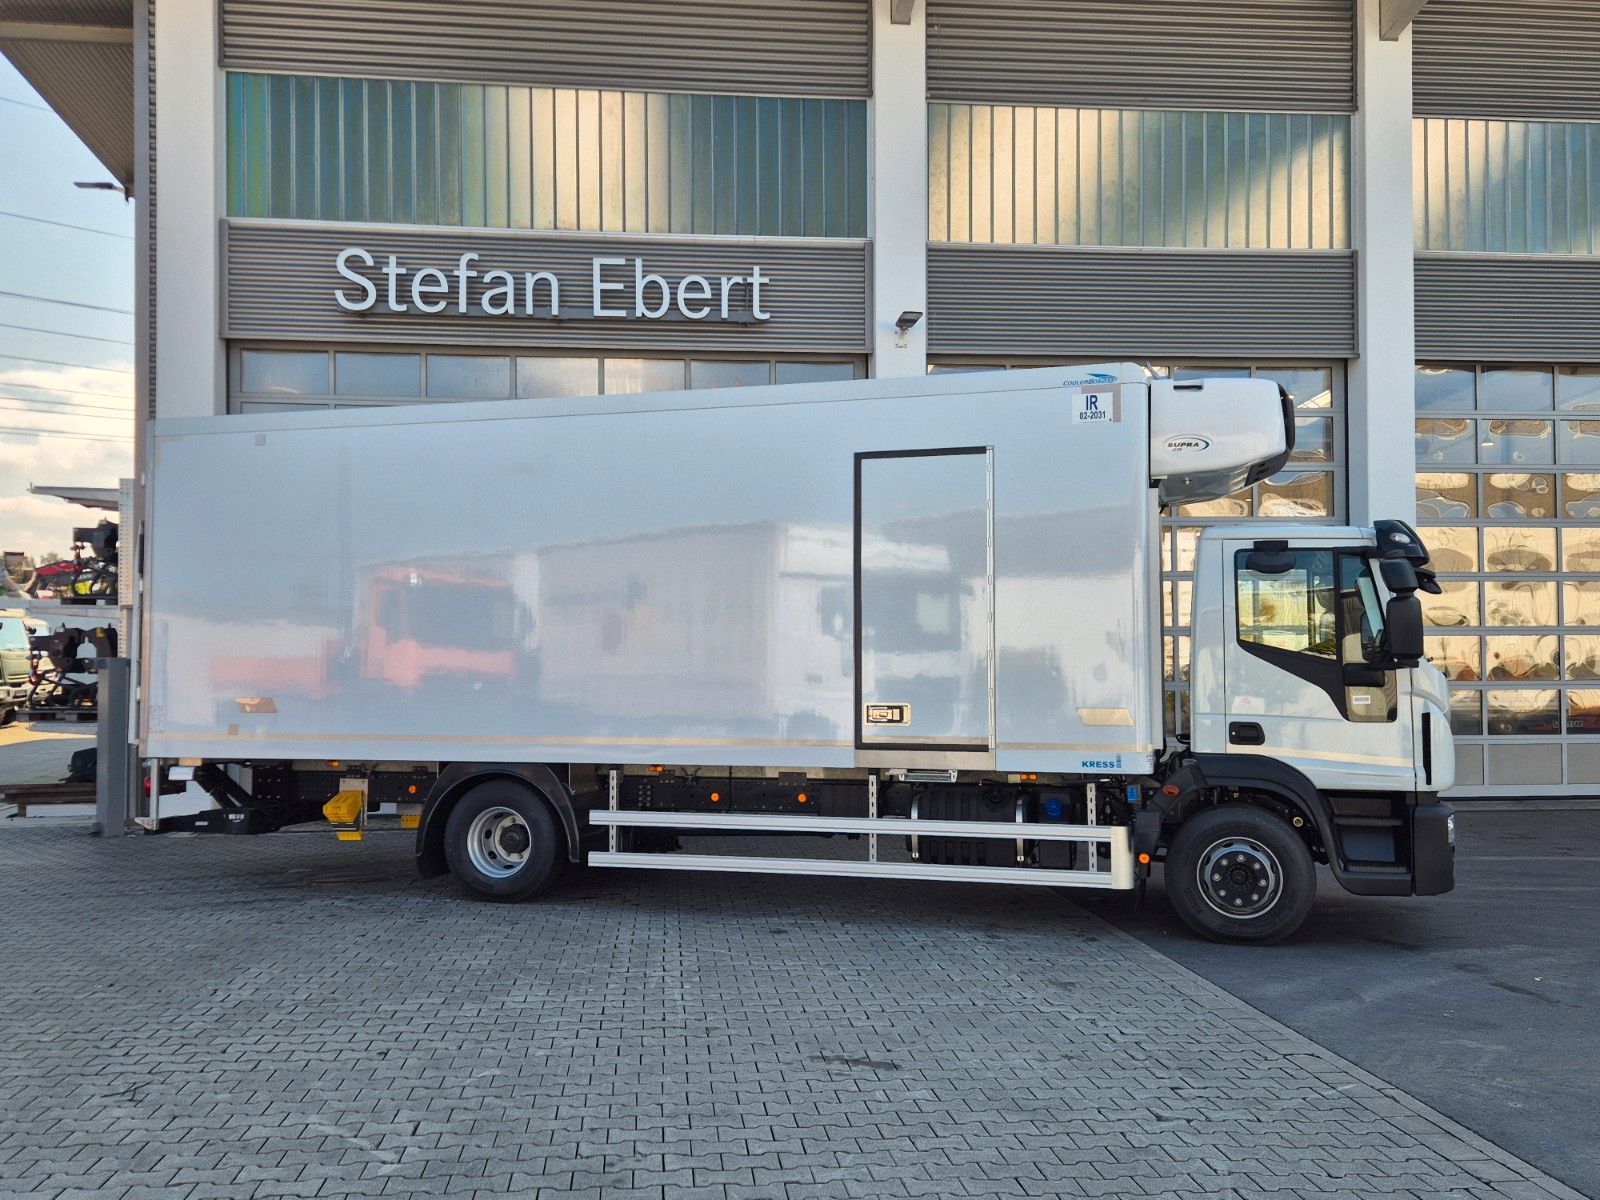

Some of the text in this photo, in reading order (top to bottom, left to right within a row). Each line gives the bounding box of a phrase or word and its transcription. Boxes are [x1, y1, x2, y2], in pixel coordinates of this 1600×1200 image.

[334, 247, 771, 320] Stefan Ebert
[1086, 394, 1098, 411] IR
[1079, 410, 1106, 420] 02-2031
[1081, 760, 1115, 769] KRESS
